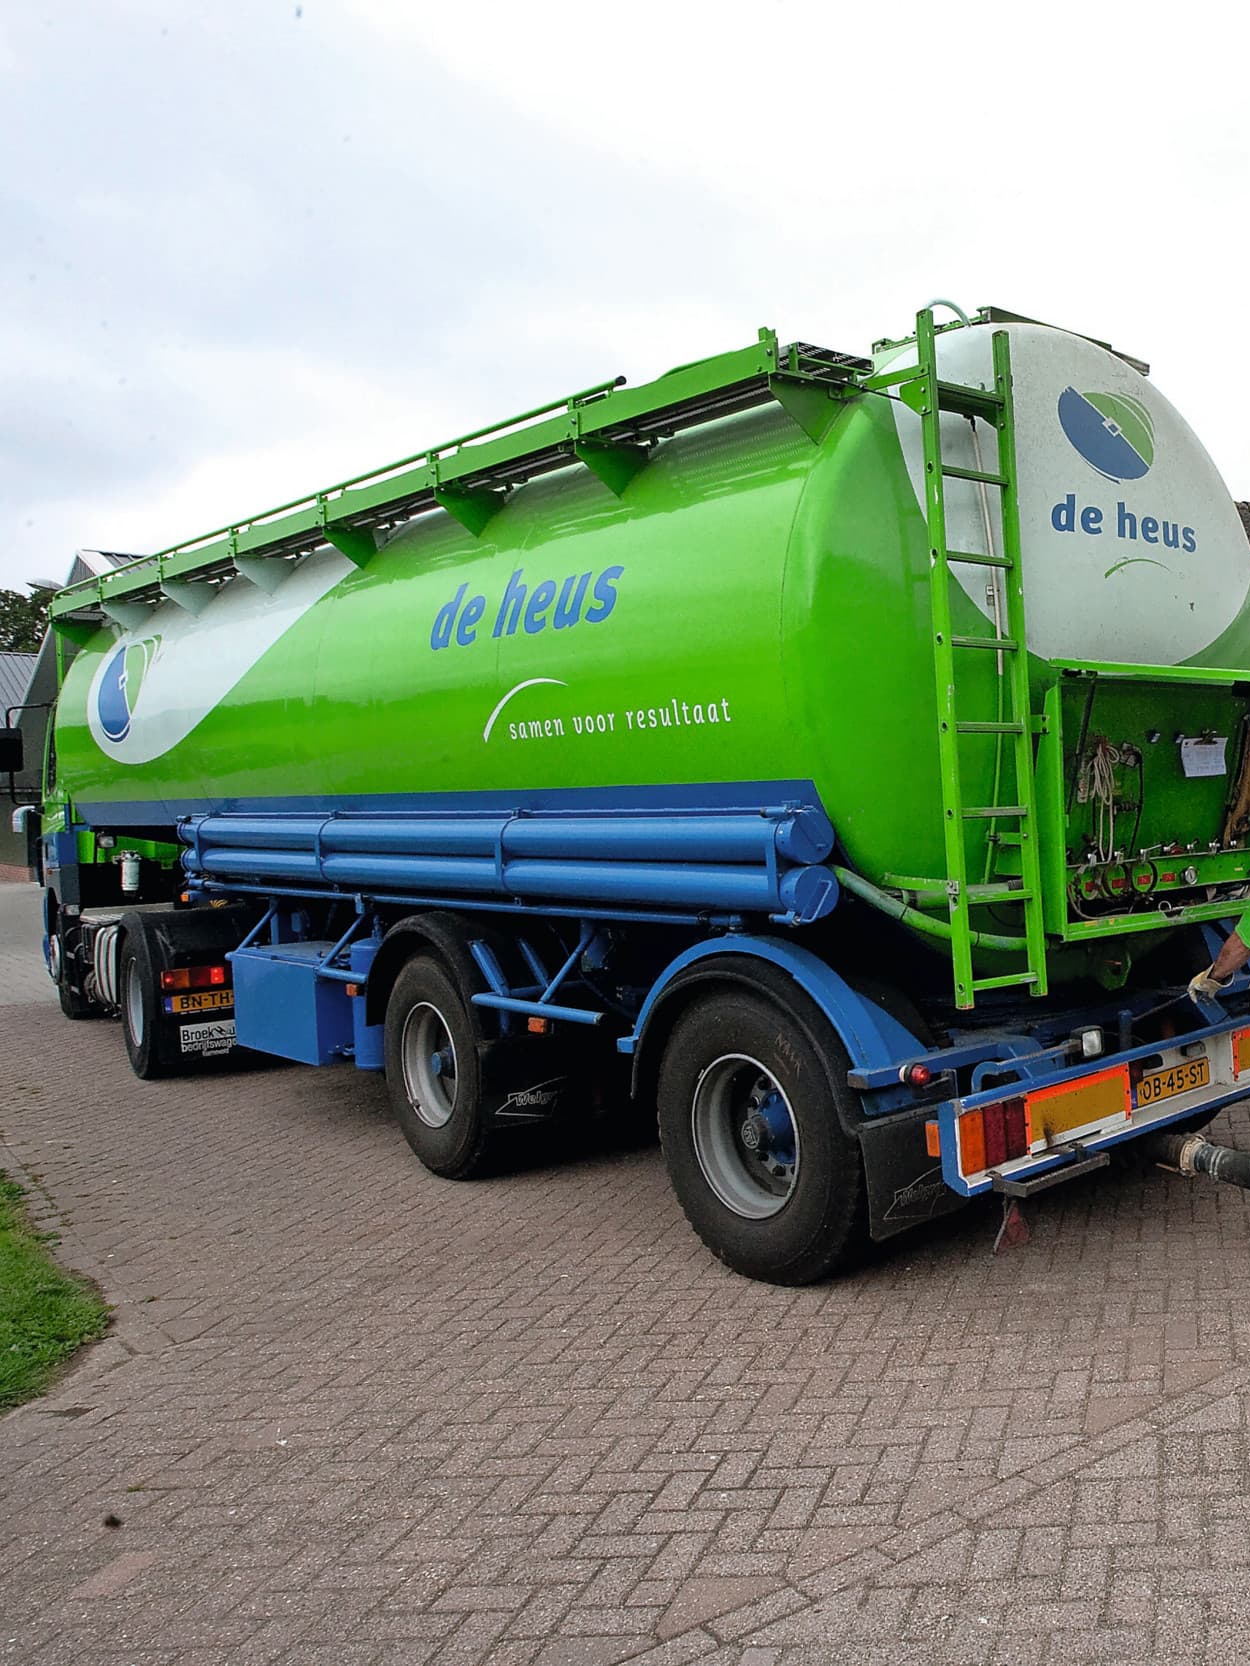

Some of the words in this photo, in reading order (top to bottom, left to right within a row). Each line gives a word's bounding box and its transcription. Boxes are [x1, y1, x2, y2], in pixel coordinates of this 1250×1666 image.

[1051, 493, 1104, 535] de
[1117, 501, 1197, 553] heus
[430, 582, 486, 651] de
[492, 565, 625, 639] heus
[508, 718, 565, 741] samen
[572, 711, 616, 736] voor
[625, 697, 732, 731] resultaat
